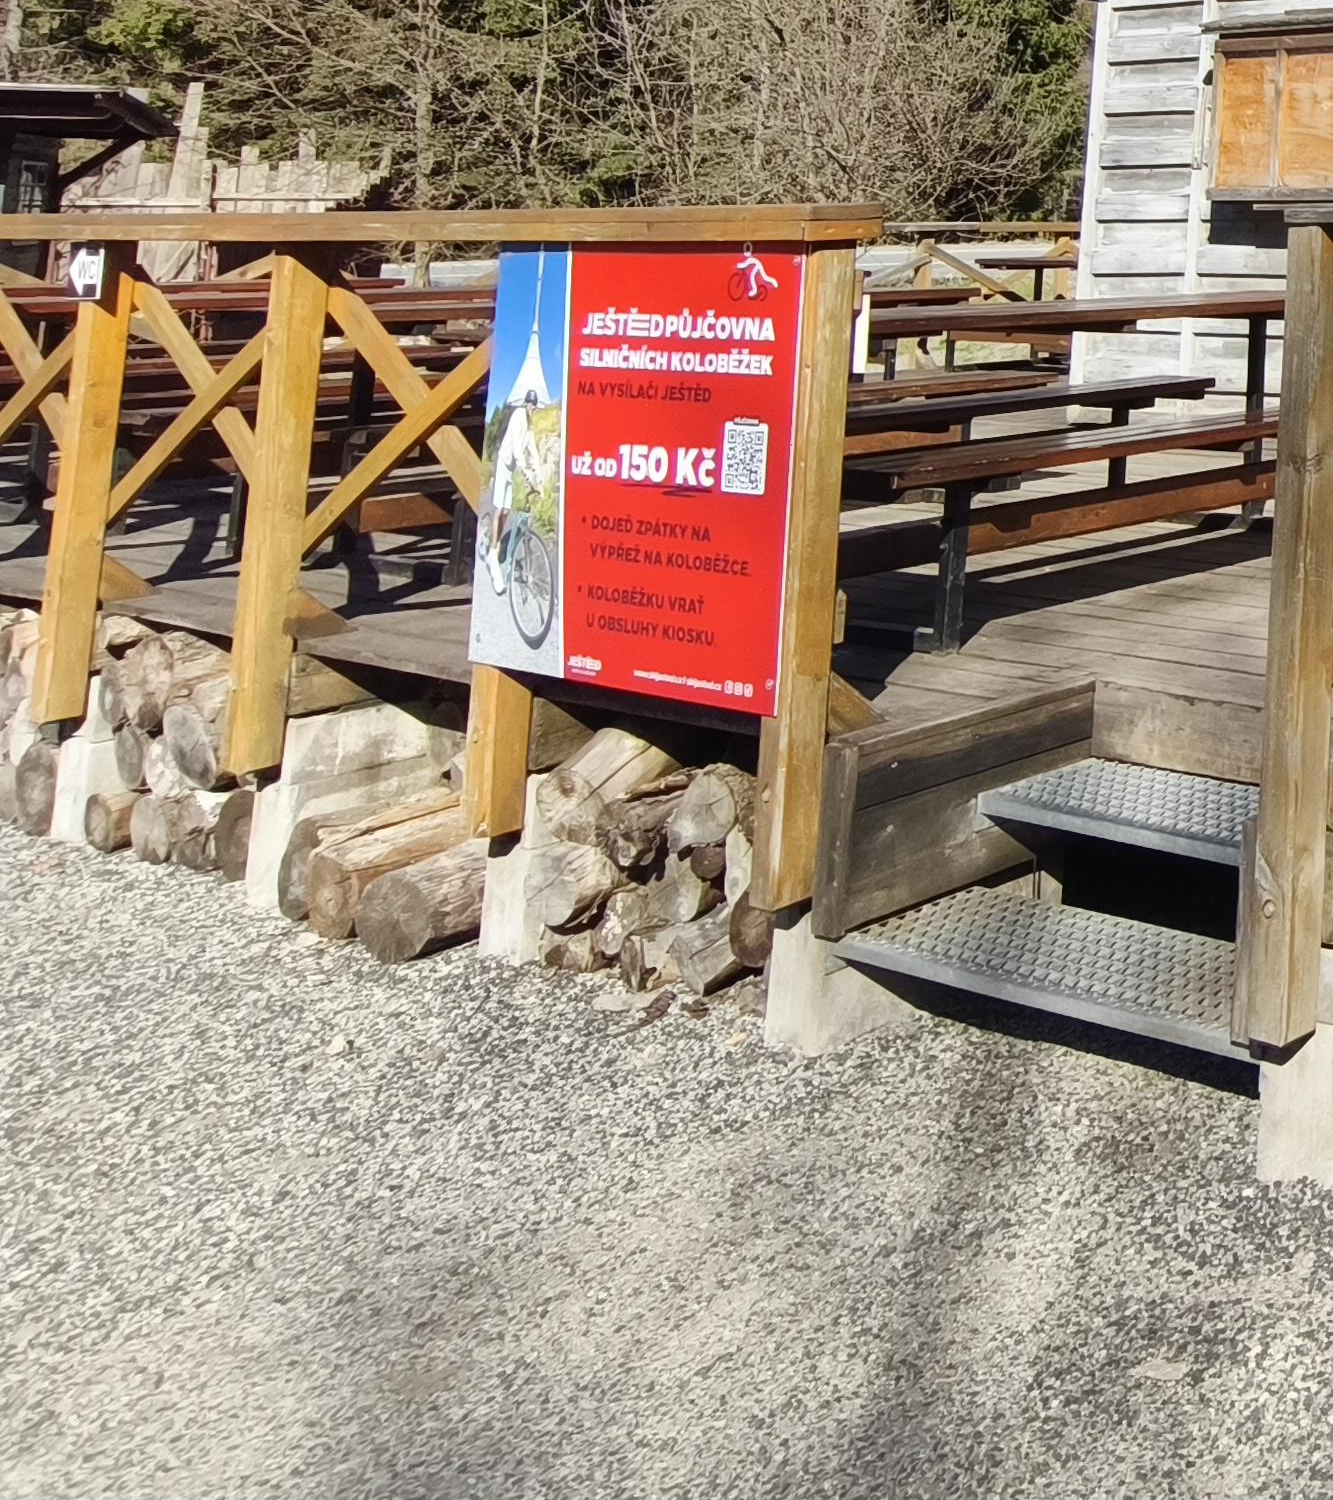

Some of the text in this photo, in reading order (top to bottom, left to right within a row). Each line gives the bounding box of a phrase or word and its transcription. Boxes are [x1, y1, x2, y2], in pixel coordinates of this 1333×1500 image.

[78, 260, 97, 280] WC
[665, 308, 775, 342] PŮJČOVNA
[580, 346, 773, 376] SILNIČNÍCH KOLOBĚŽEK
[577, 380, 712, 403] NA VYSÍLAČI JEŠTĚD
[571, 444, 716, 488] UŽ OD 150 Kč
[591, 514, 711, 543] DOJEĎ ZPÁTKY NA
[589, 543, 641, 564] VÝPŘEŽ
[643, 550, 663, 567] NA
[587, 584, 705, 615] KOLOBĚŽKU VRAŤ
[586, 616, 594, 629] U
[597, 617, 659, 638] OBSLUHY
